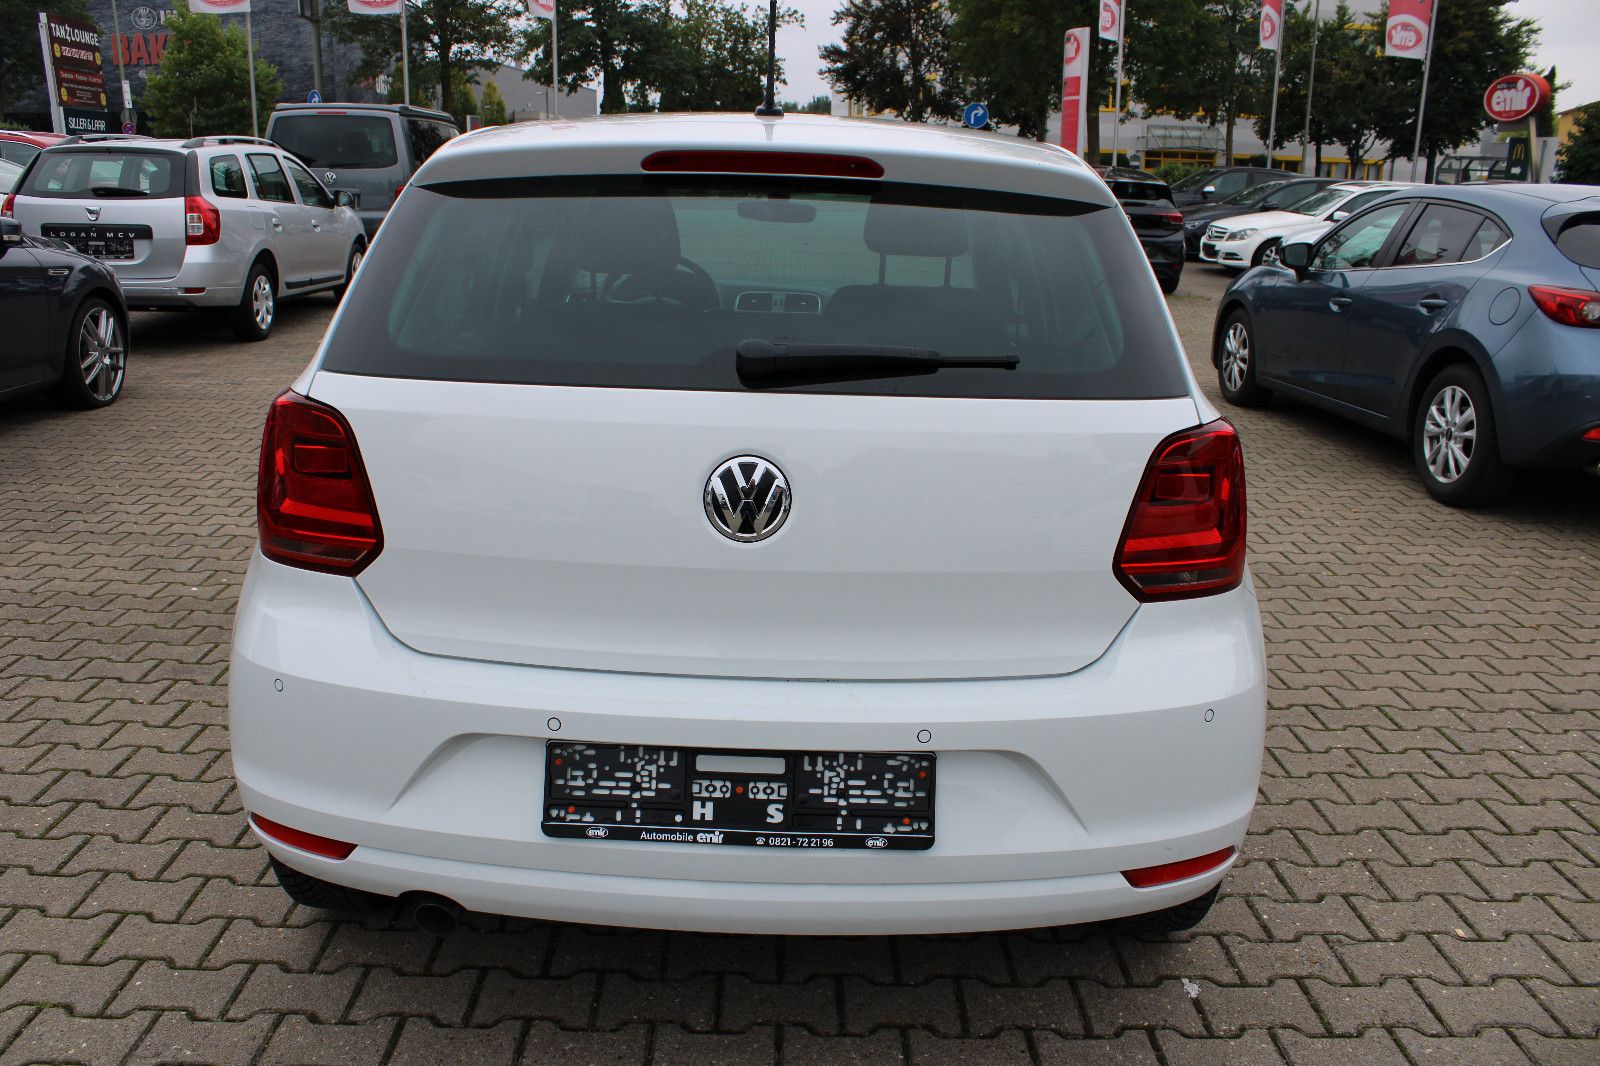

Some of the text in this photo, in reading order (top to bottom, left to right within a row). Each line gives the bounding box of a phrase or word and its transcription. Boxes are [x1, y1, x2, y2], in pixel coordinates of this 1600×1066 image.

[50, 22, 100, 46] TANZLOUNGE
[111, 31, 169, 65] BAK
[1492, 79, 1531, 111] emir
[692, 800, 714, 821] H
[765, 803, 784, 824] S
[587, 827, 607, 837] emir
[640, 830, 694, 842] Automobile
[696, 830, 725, 844] emir
[866, 837, 886, 848] emir
